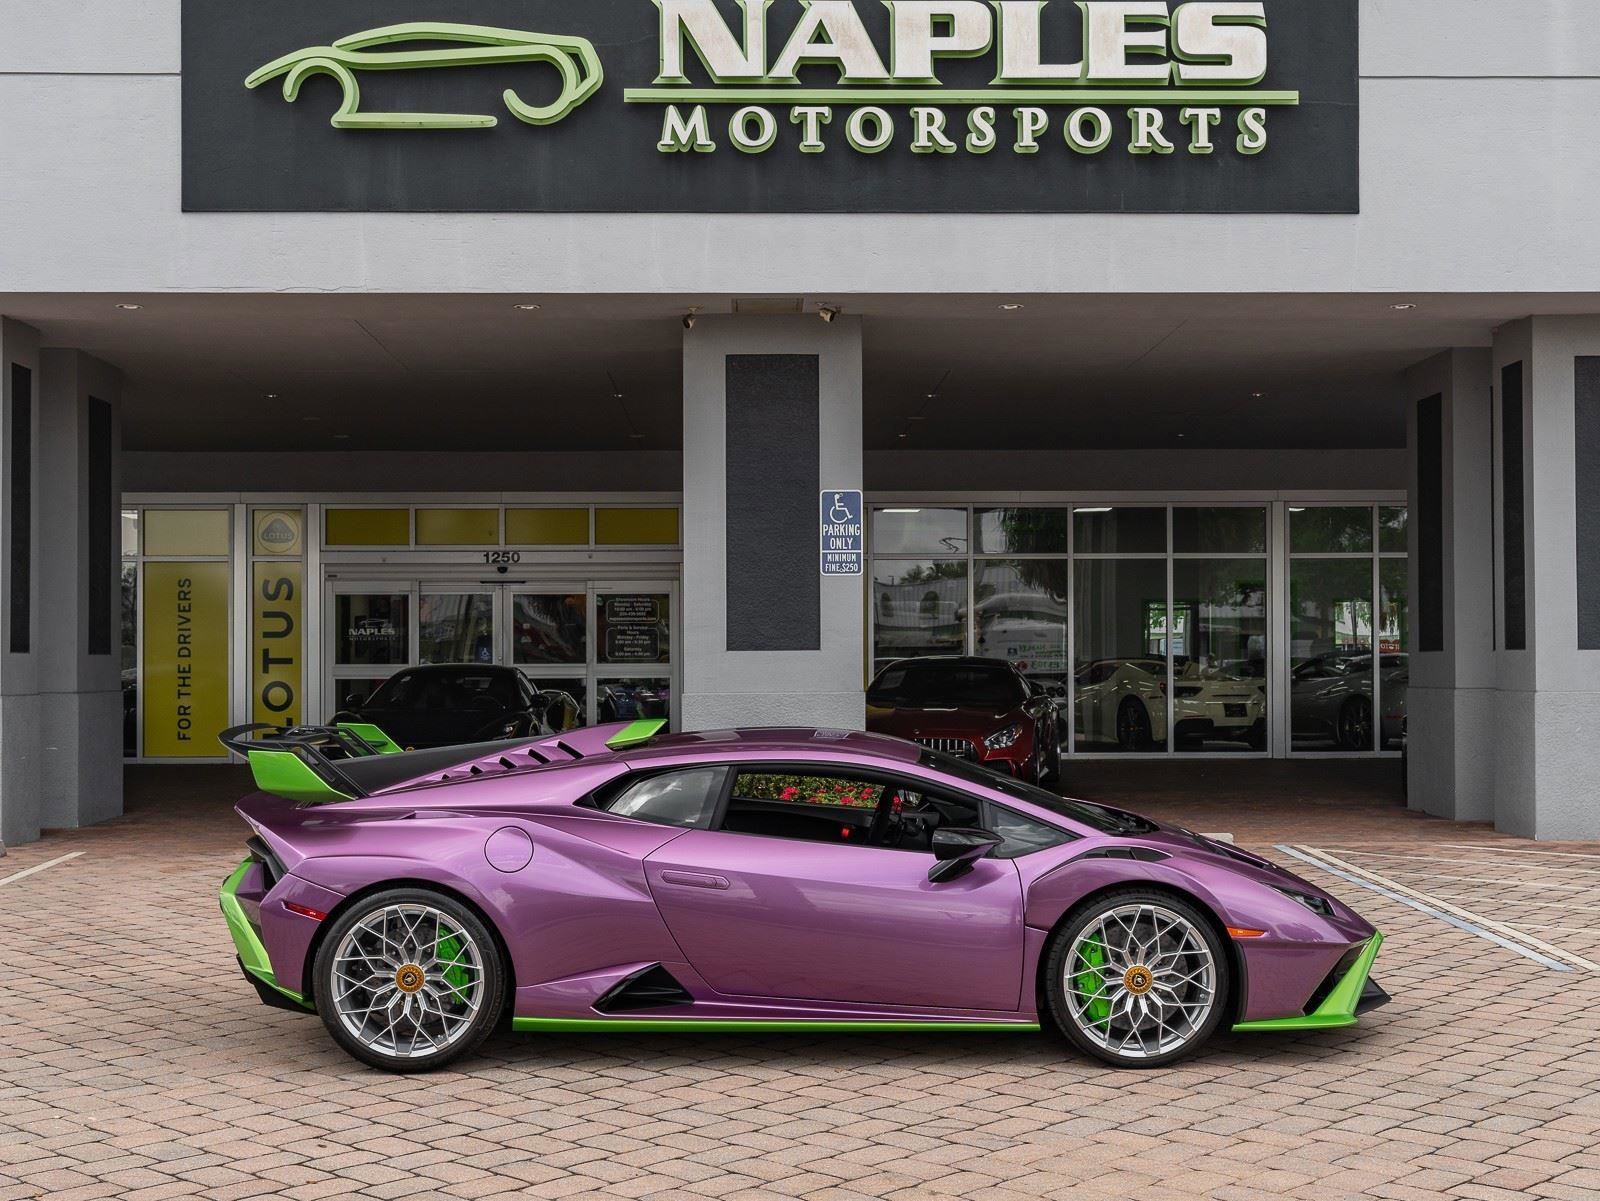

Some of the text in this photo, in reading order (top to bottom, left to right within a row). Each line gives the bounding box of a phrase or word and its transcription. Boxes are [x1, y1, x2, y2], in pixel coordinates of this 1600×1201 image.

[652, 0, 1268, 86] NAPLES
[656, 104, 1268, 155] MOTORSPORTS
[822, 523, 861, 536] PARKING
[829, 537, 853, 550] ONLY
[483, 551, 521, 564] 1250
[827, 553, 857, 562] MINIMUM
[825, 563, 859, 572] FINE $250
[348, 628, 396, 636] NAPLES
[177, 577, 192, 741] FOR THE DRIVERS
